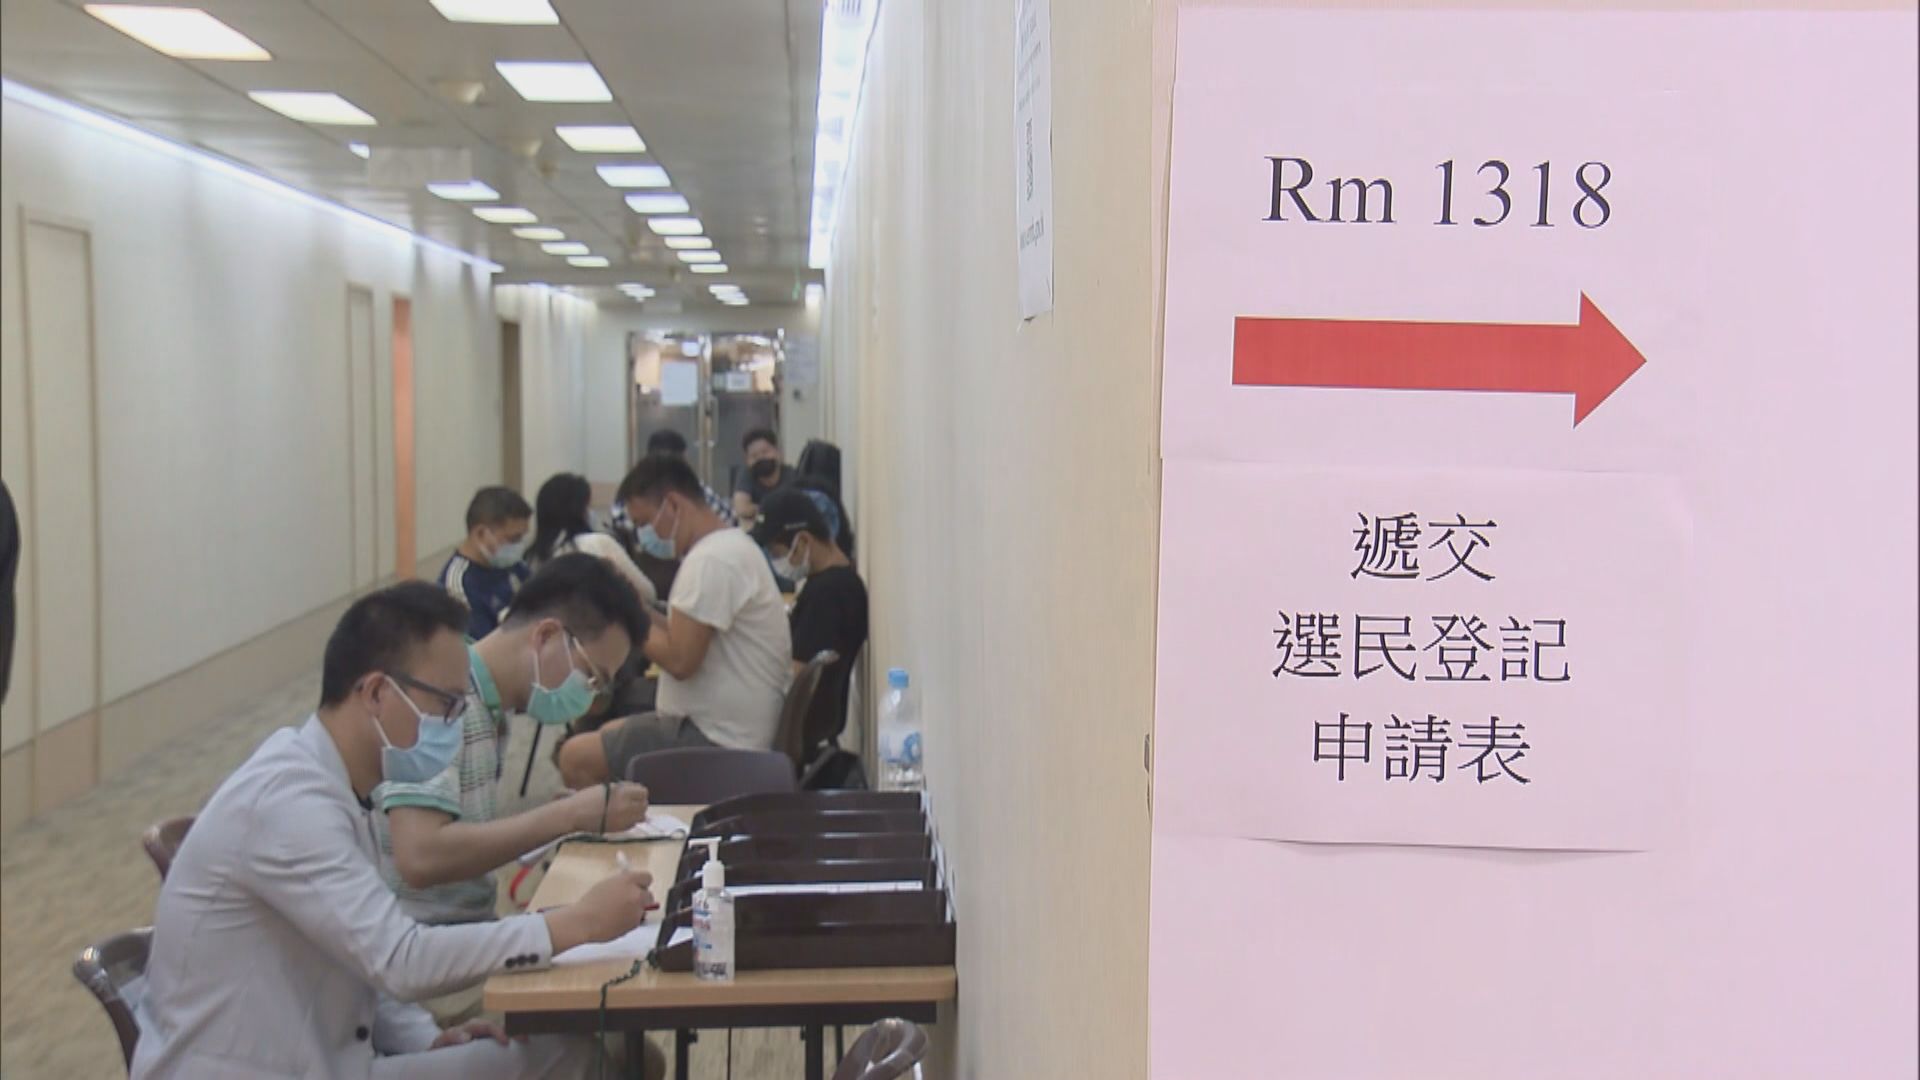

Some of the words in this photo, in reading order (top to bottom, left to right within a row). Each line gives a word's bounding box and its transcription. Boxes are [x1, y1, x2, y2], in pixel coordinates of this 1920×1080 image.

[1261, 156, 1396, 224] Rm
[1433, 159, 1612, 229] 1318
[1350, 511, 1498, 582] 遞交
[1272, 610, 1571, 682] 選民登記
[1313, 712, 1531, 785] 申請表
